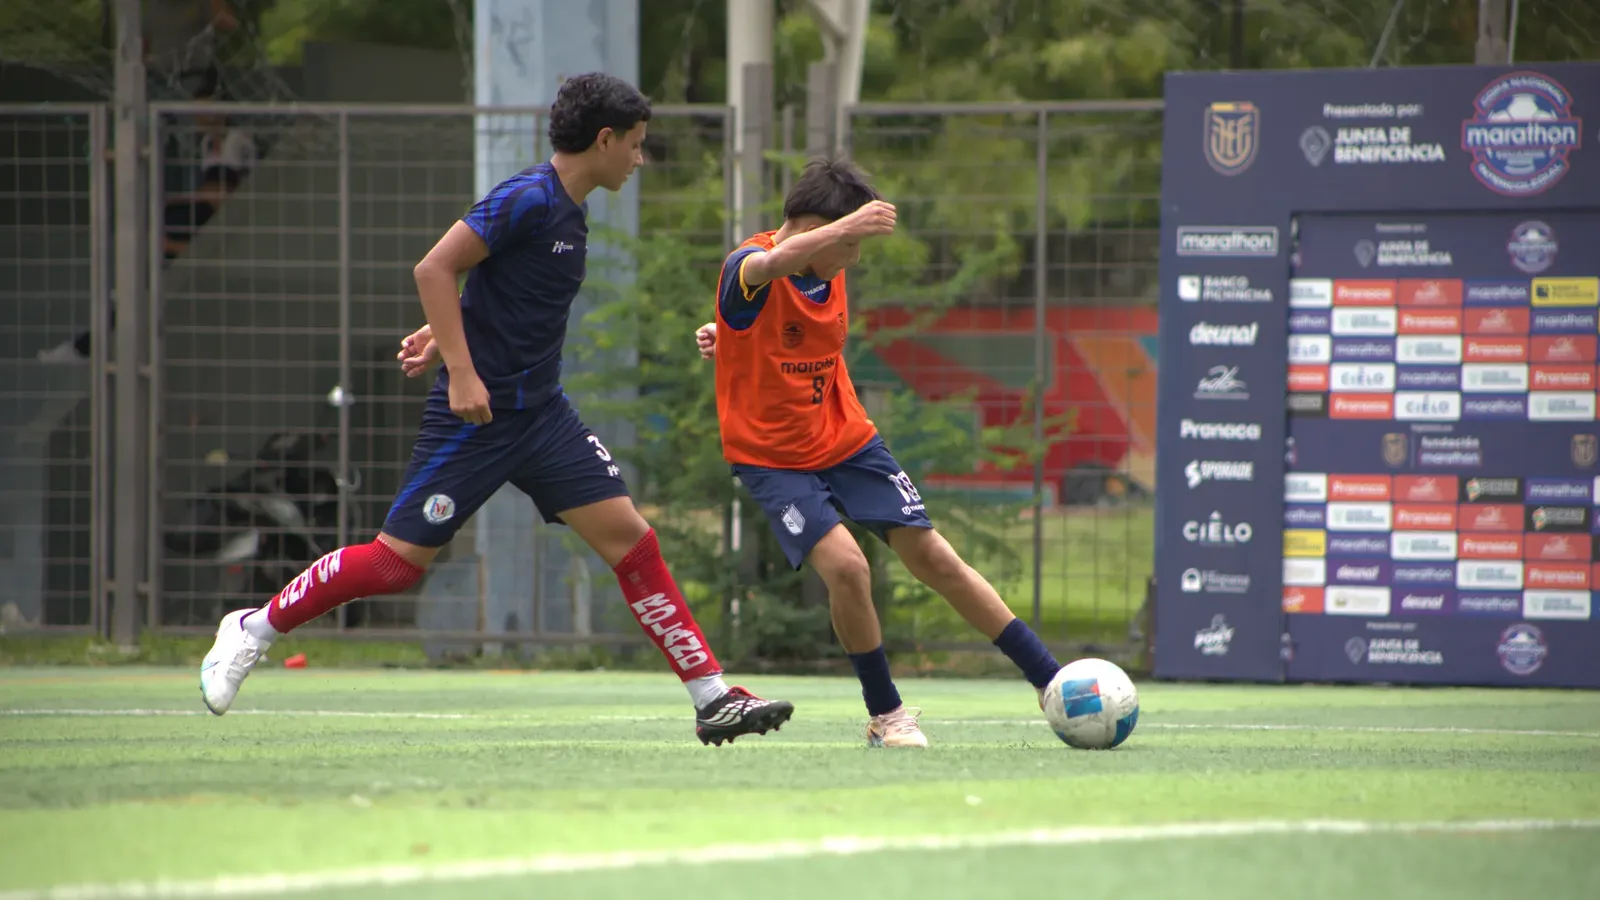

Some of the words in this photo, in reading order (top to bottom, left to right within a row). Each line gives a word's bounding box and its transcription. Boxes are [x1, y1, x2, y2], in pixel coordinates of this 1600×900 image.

[1334, 127, 1388, 145] JUNTA
[1389, 126, 1412, 144] DE
[1466, 122, 1575, 146] marathon
[1334, 143, 1446, 163] BENEFICENCIA
[1181, 231, 1273, 251] marathon
[1203, 275, 1249, 288] BANCO
[1203, 288, 1273, 302] PICHINCHA
[1179, 418, 1262, 440] Pronaca
[587, 434, 612, 462] 3
[631, 592, 709, 672] ROLAND
